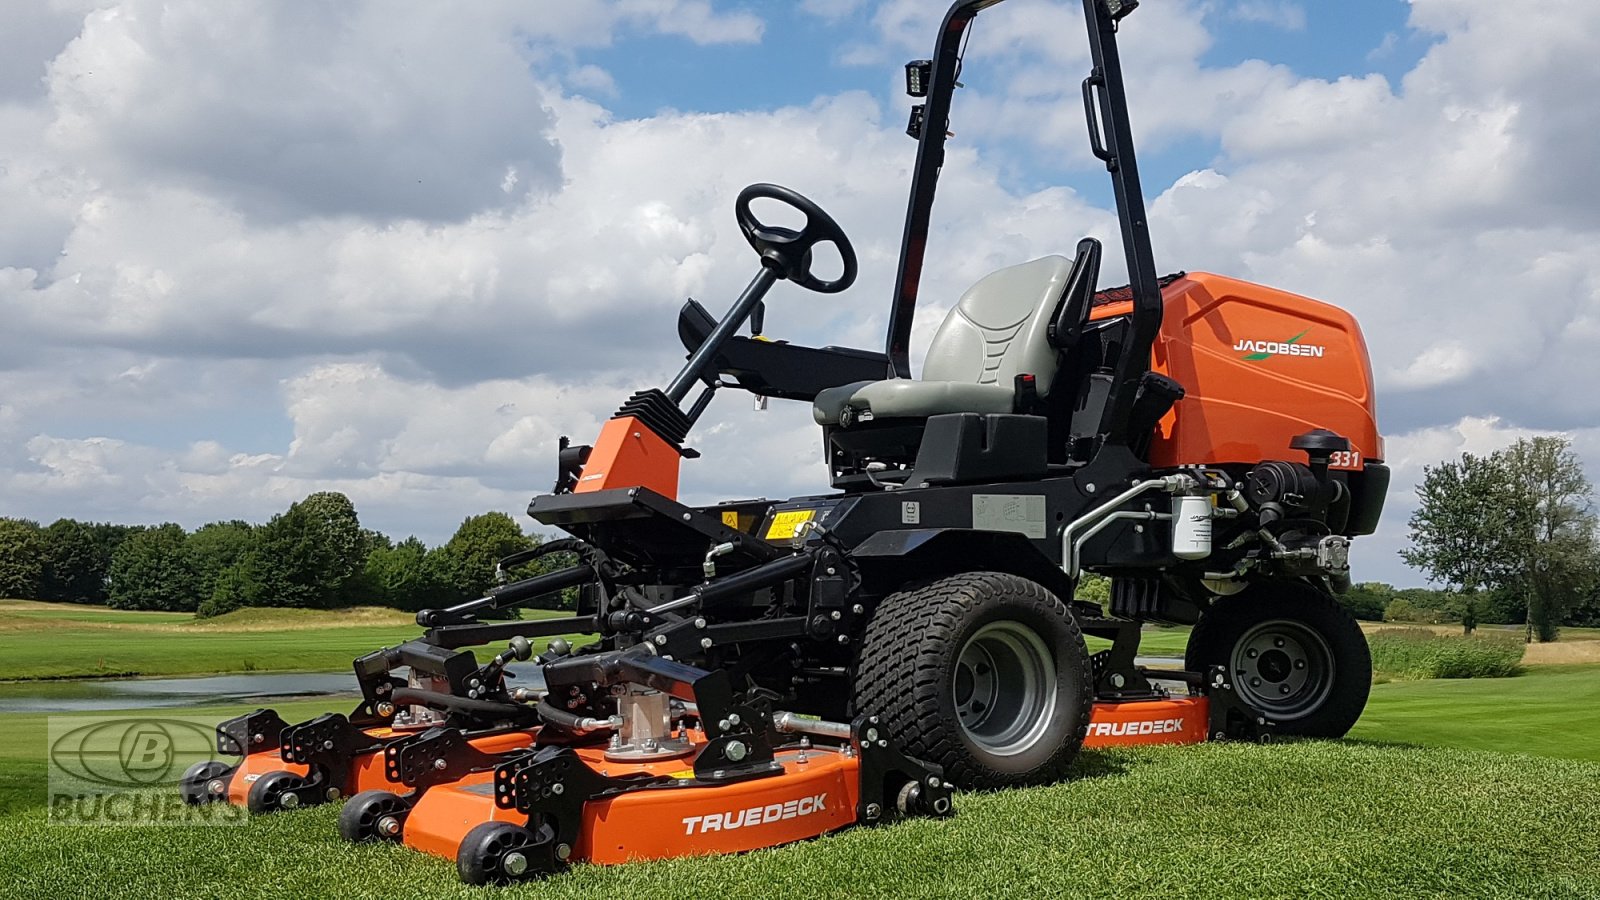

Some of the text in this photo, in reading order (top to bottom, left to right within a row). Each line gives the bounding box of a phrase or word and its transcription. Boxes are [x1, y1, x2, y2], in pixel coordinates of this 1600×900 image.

[1233, 339, 1323, 357] JACOBSEN
[1085, 718, 1184, 737] TRUEDECK
[682, 793, 827, 835] TRUEDECK
